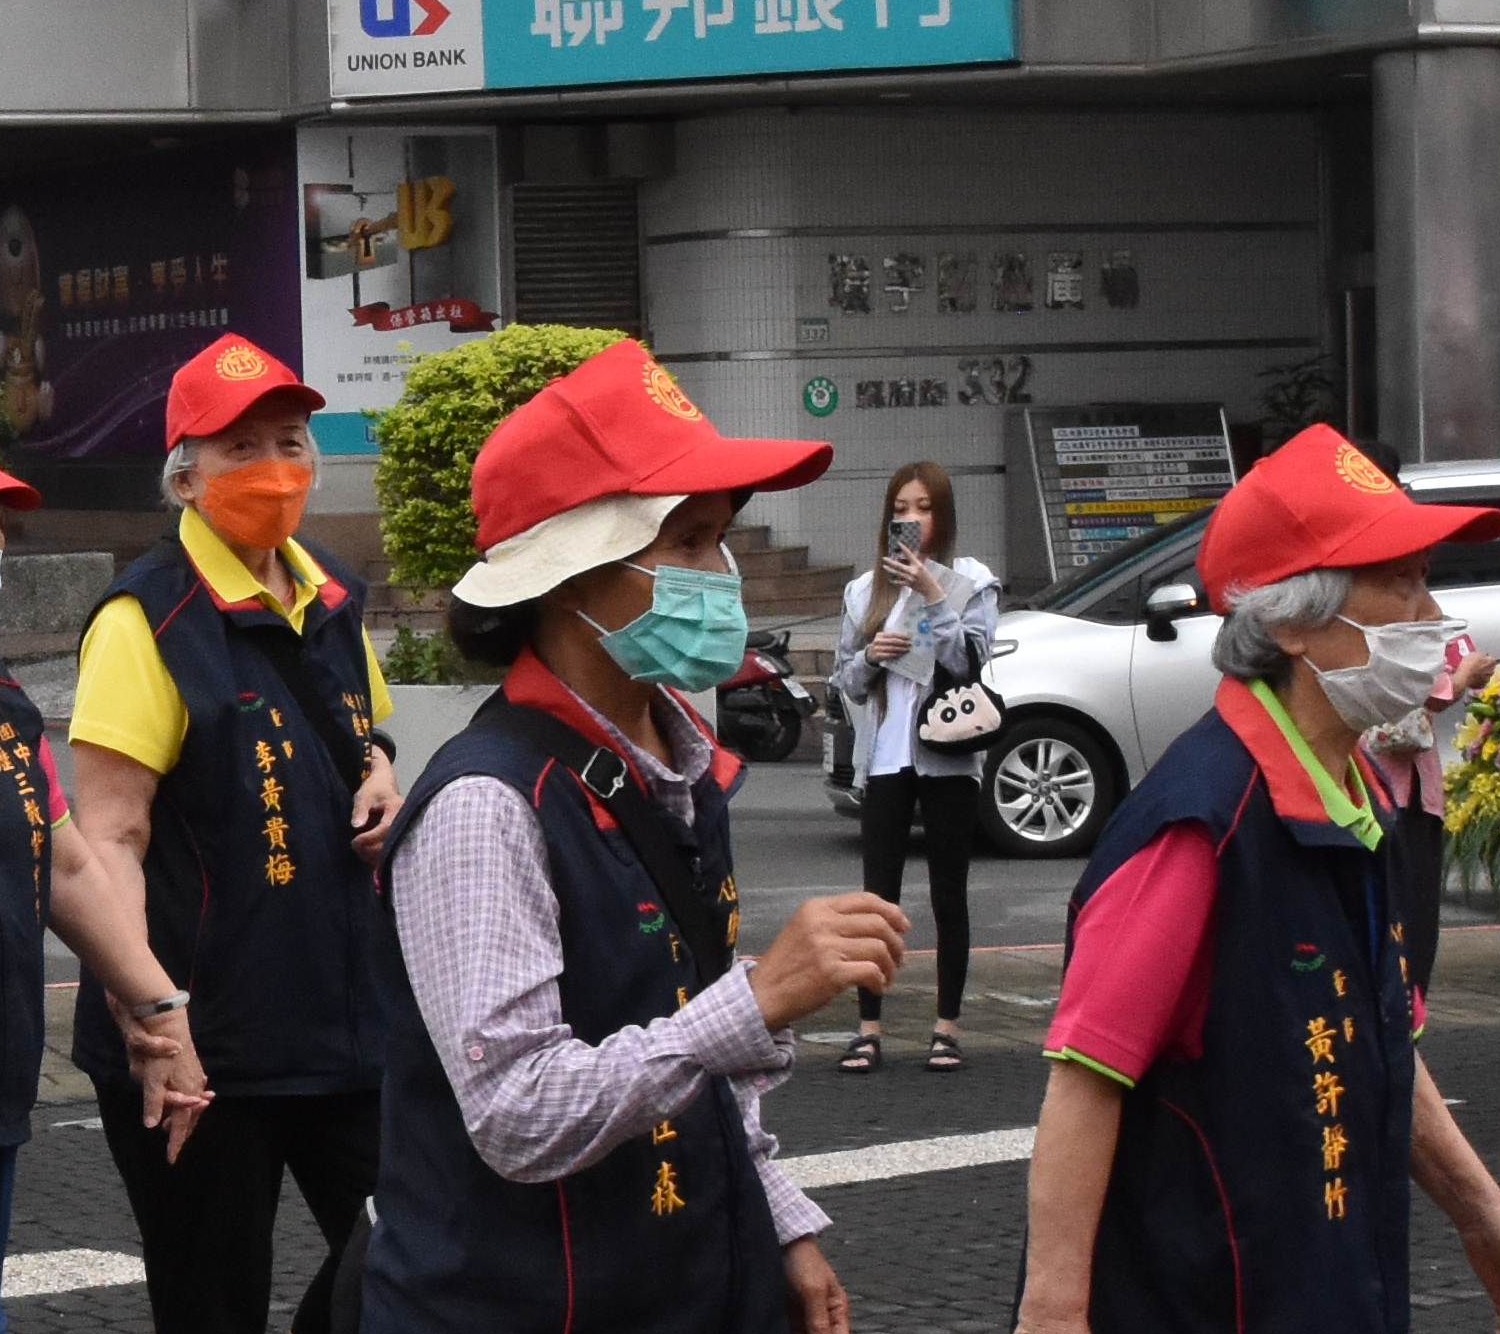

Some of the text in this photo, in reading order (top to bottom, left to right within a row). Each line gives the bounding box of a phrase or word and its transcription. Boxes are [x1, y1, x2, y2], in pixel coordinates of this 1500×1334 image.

[346, 48, 466, 72] UNION BANK
[253, 739, 298, 888] 李黃貴梅
